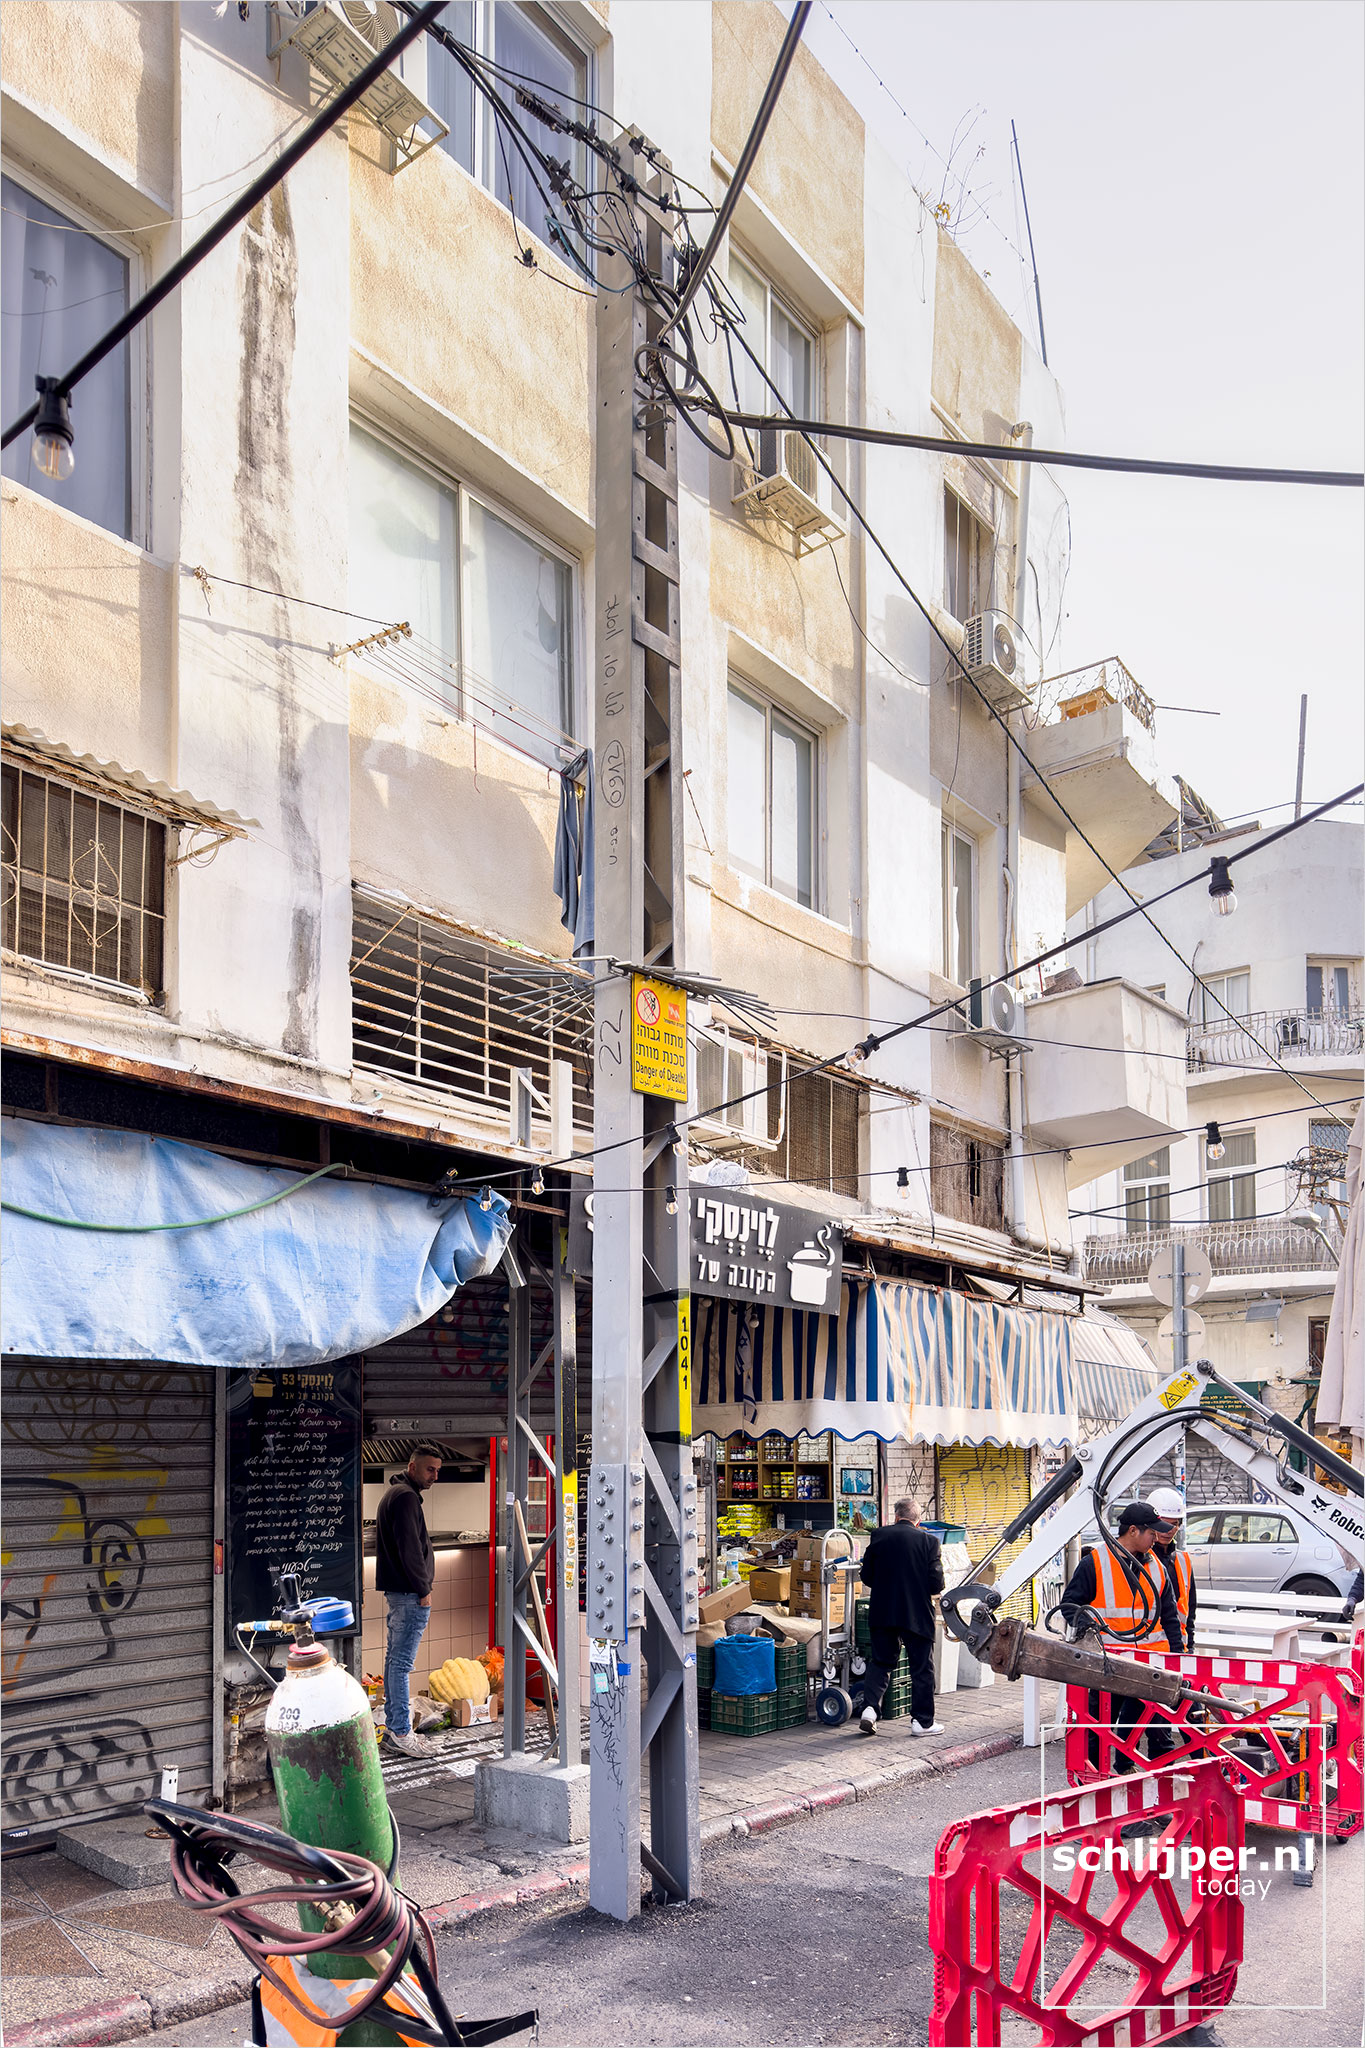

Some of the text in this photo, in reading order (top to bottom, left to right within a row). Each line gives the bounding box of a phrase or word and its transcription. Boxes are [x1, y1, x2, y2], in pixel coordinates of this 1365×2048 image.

[636, 1024, 684, 1049] מתח גבוה!
[635, 1043, 685, 1068] סכנת מוות!
[635, 1060, 686, 1085] Danger of Death!
[697, 1253, 776, 1295] הקובה של
[681, 1316, 690, 1391] 1041
[282, 1373, 295, 1385] 53
[311, 1392, 334, 1401] הקובה
[281, 1556, 315, 1574] טבעוני
[279, 1706, 301, 1721] 200
